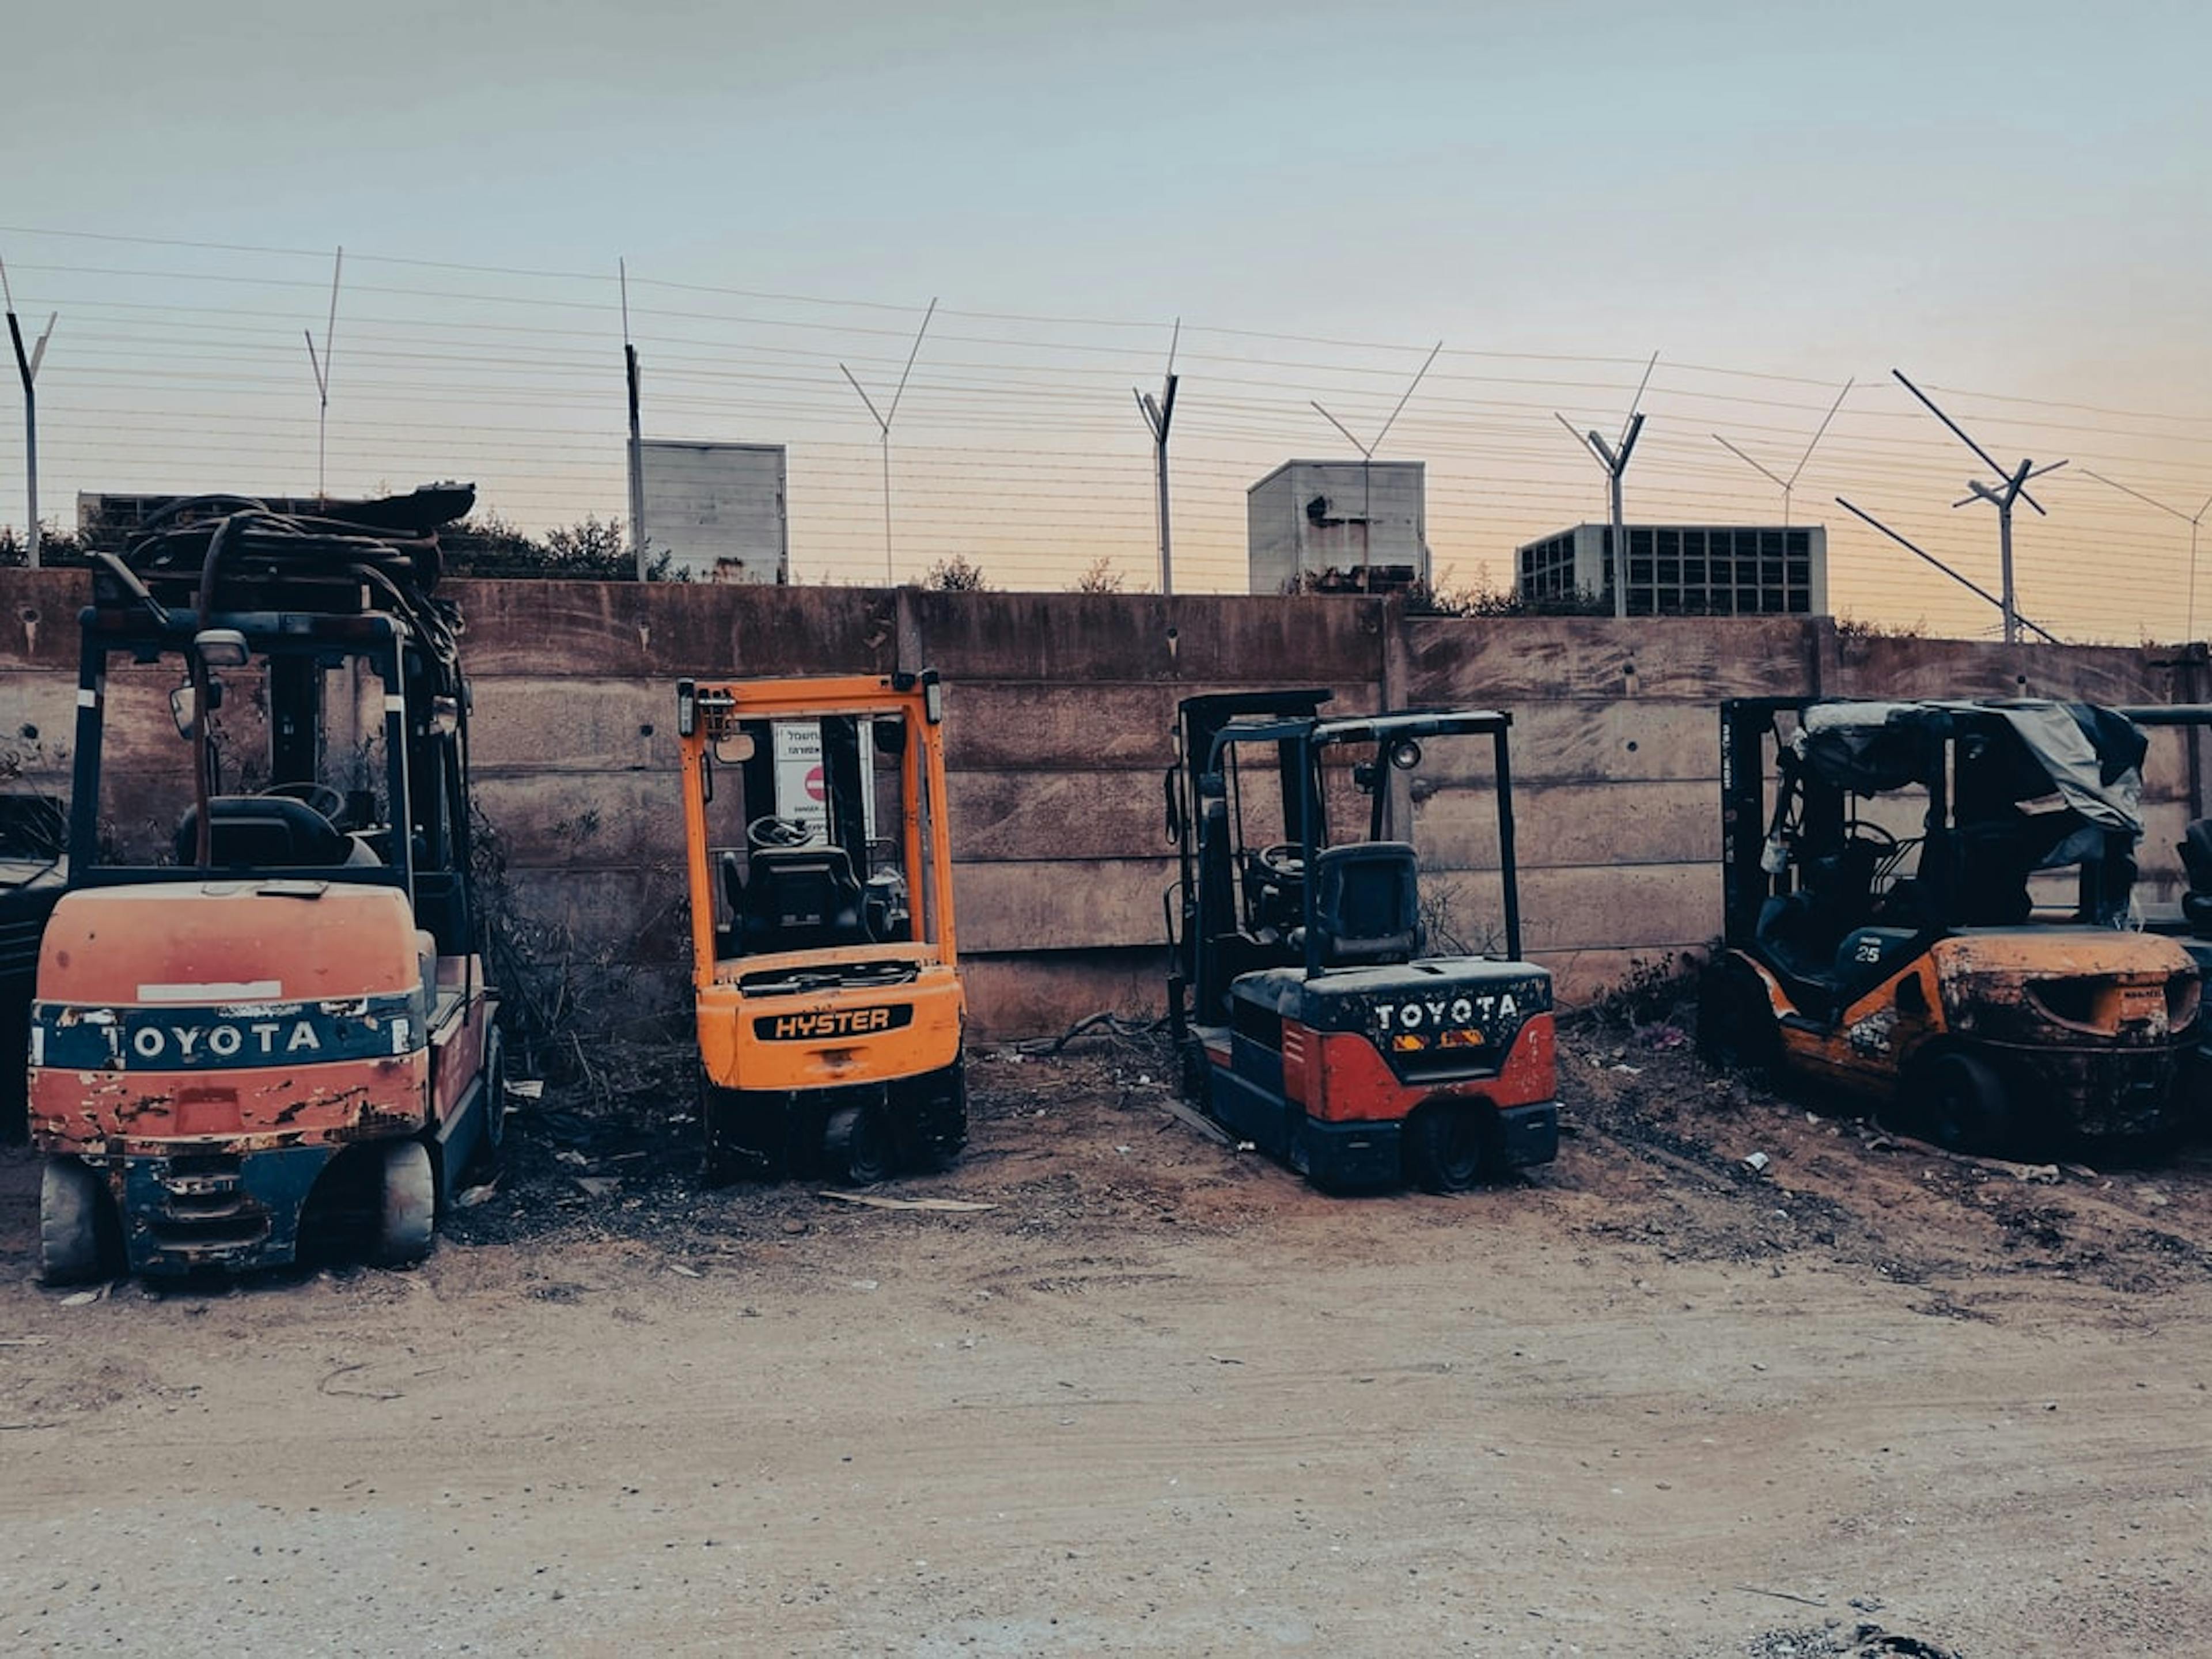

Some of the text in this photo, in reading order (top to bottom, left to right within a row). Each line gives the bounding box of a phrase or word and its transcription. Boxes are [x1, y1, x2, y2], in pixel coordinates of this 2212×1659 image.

[1854, 945, 1880, 963] 25
[775, 1009, 890, 1038] HYSTER
[1374, 994, 1517, 1029] TOYOTA
